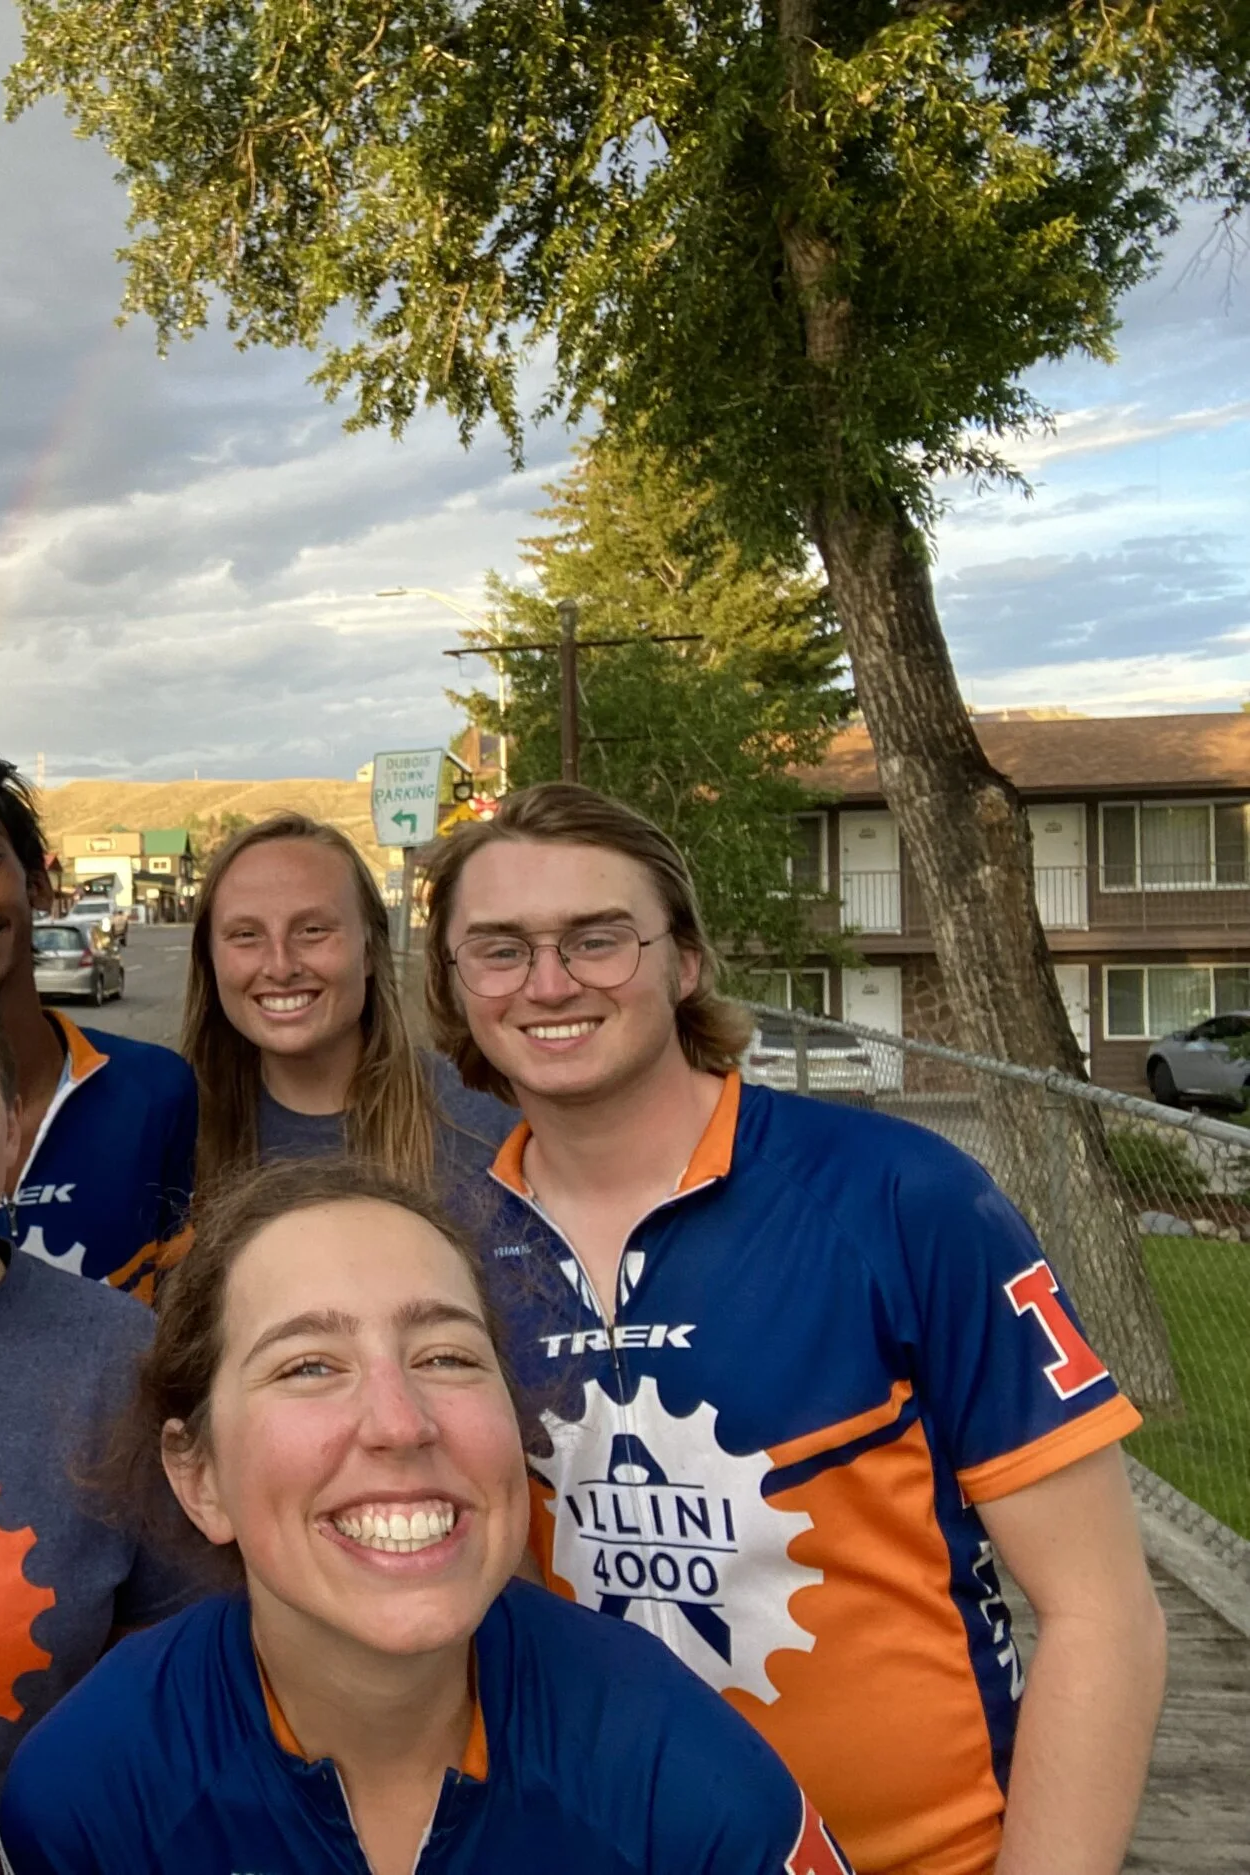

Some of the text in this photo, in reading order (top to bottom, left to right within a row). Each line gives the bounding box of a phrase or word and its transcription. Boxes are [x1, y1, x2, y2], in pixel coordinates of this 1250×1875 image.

[386, 755, 431, 770] DUBOIS
[374, 784, 435, 805] PARKING
[539, 1324, 697, 1358] TREK
[565, 1490, 736, 1542] ILLINI
[593, 1548, 719, 1597] 4000
